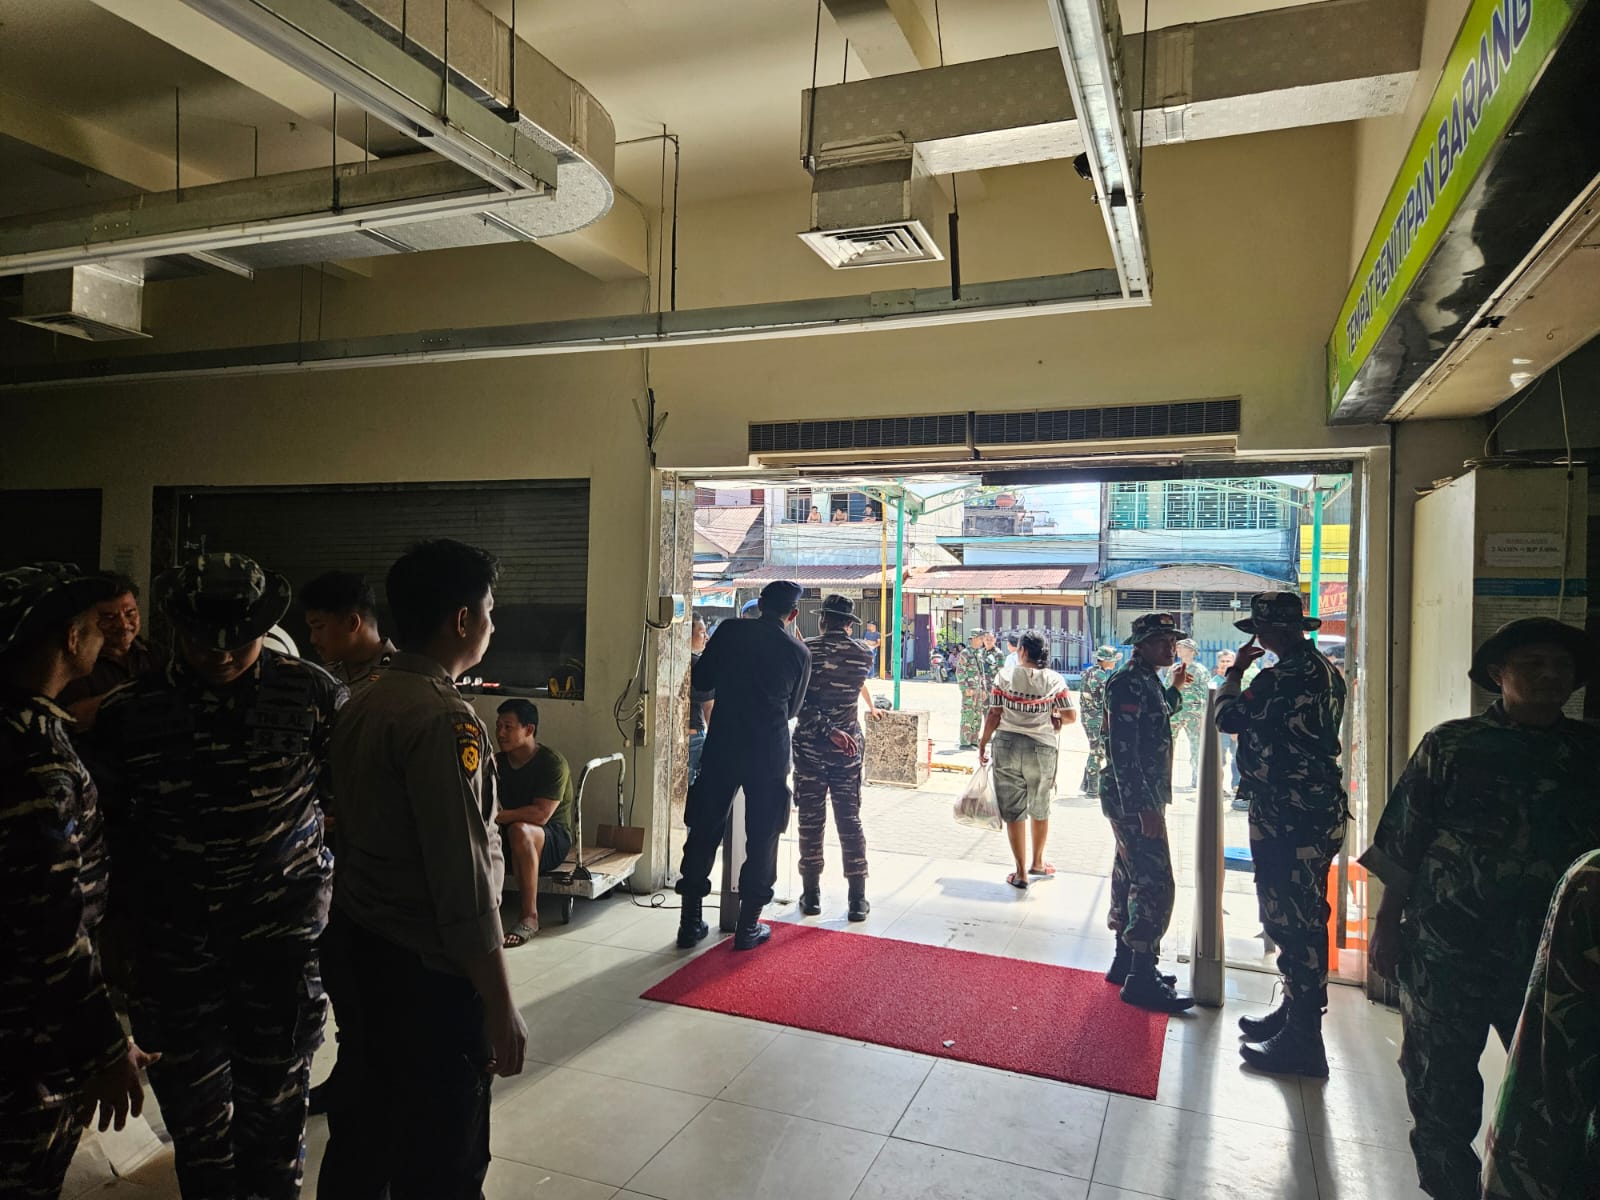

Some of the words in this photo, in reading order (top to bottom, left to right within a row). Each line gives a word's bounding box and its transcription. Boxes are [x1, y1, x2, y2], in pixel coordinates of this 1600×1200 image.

[1346, 270, 1376, 360] TEMPAT
[1374, 142, 1435, 309] PENITIPAN
[1436, 0, 1532, 195] BARANG
